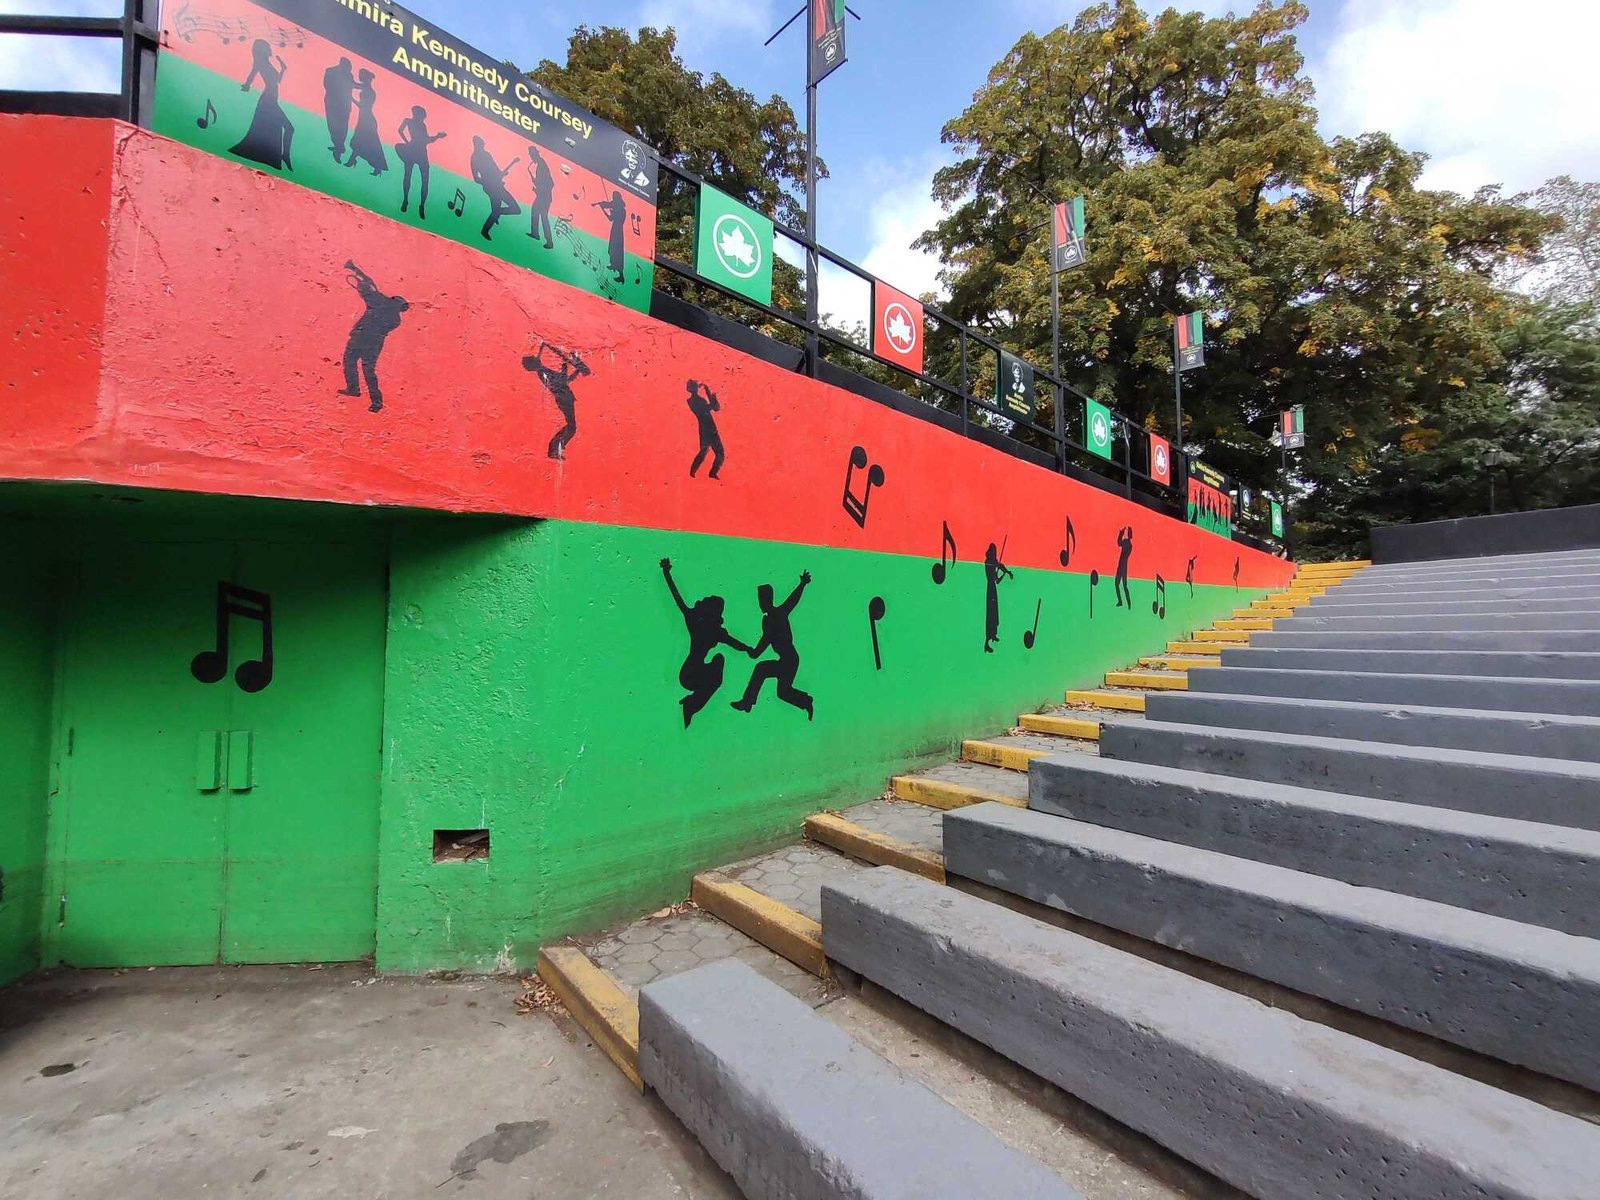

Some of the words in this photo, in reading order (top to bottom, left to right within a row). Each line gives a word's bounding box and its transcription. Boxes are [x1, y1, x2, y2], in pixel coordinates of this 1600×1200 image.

[335, 0, 404, 37] mira
[411, 24, 510, 95] Kennedy
[514, 82, 593, 140] Coursey
[392, 46, 541, 134] Amphitheater
